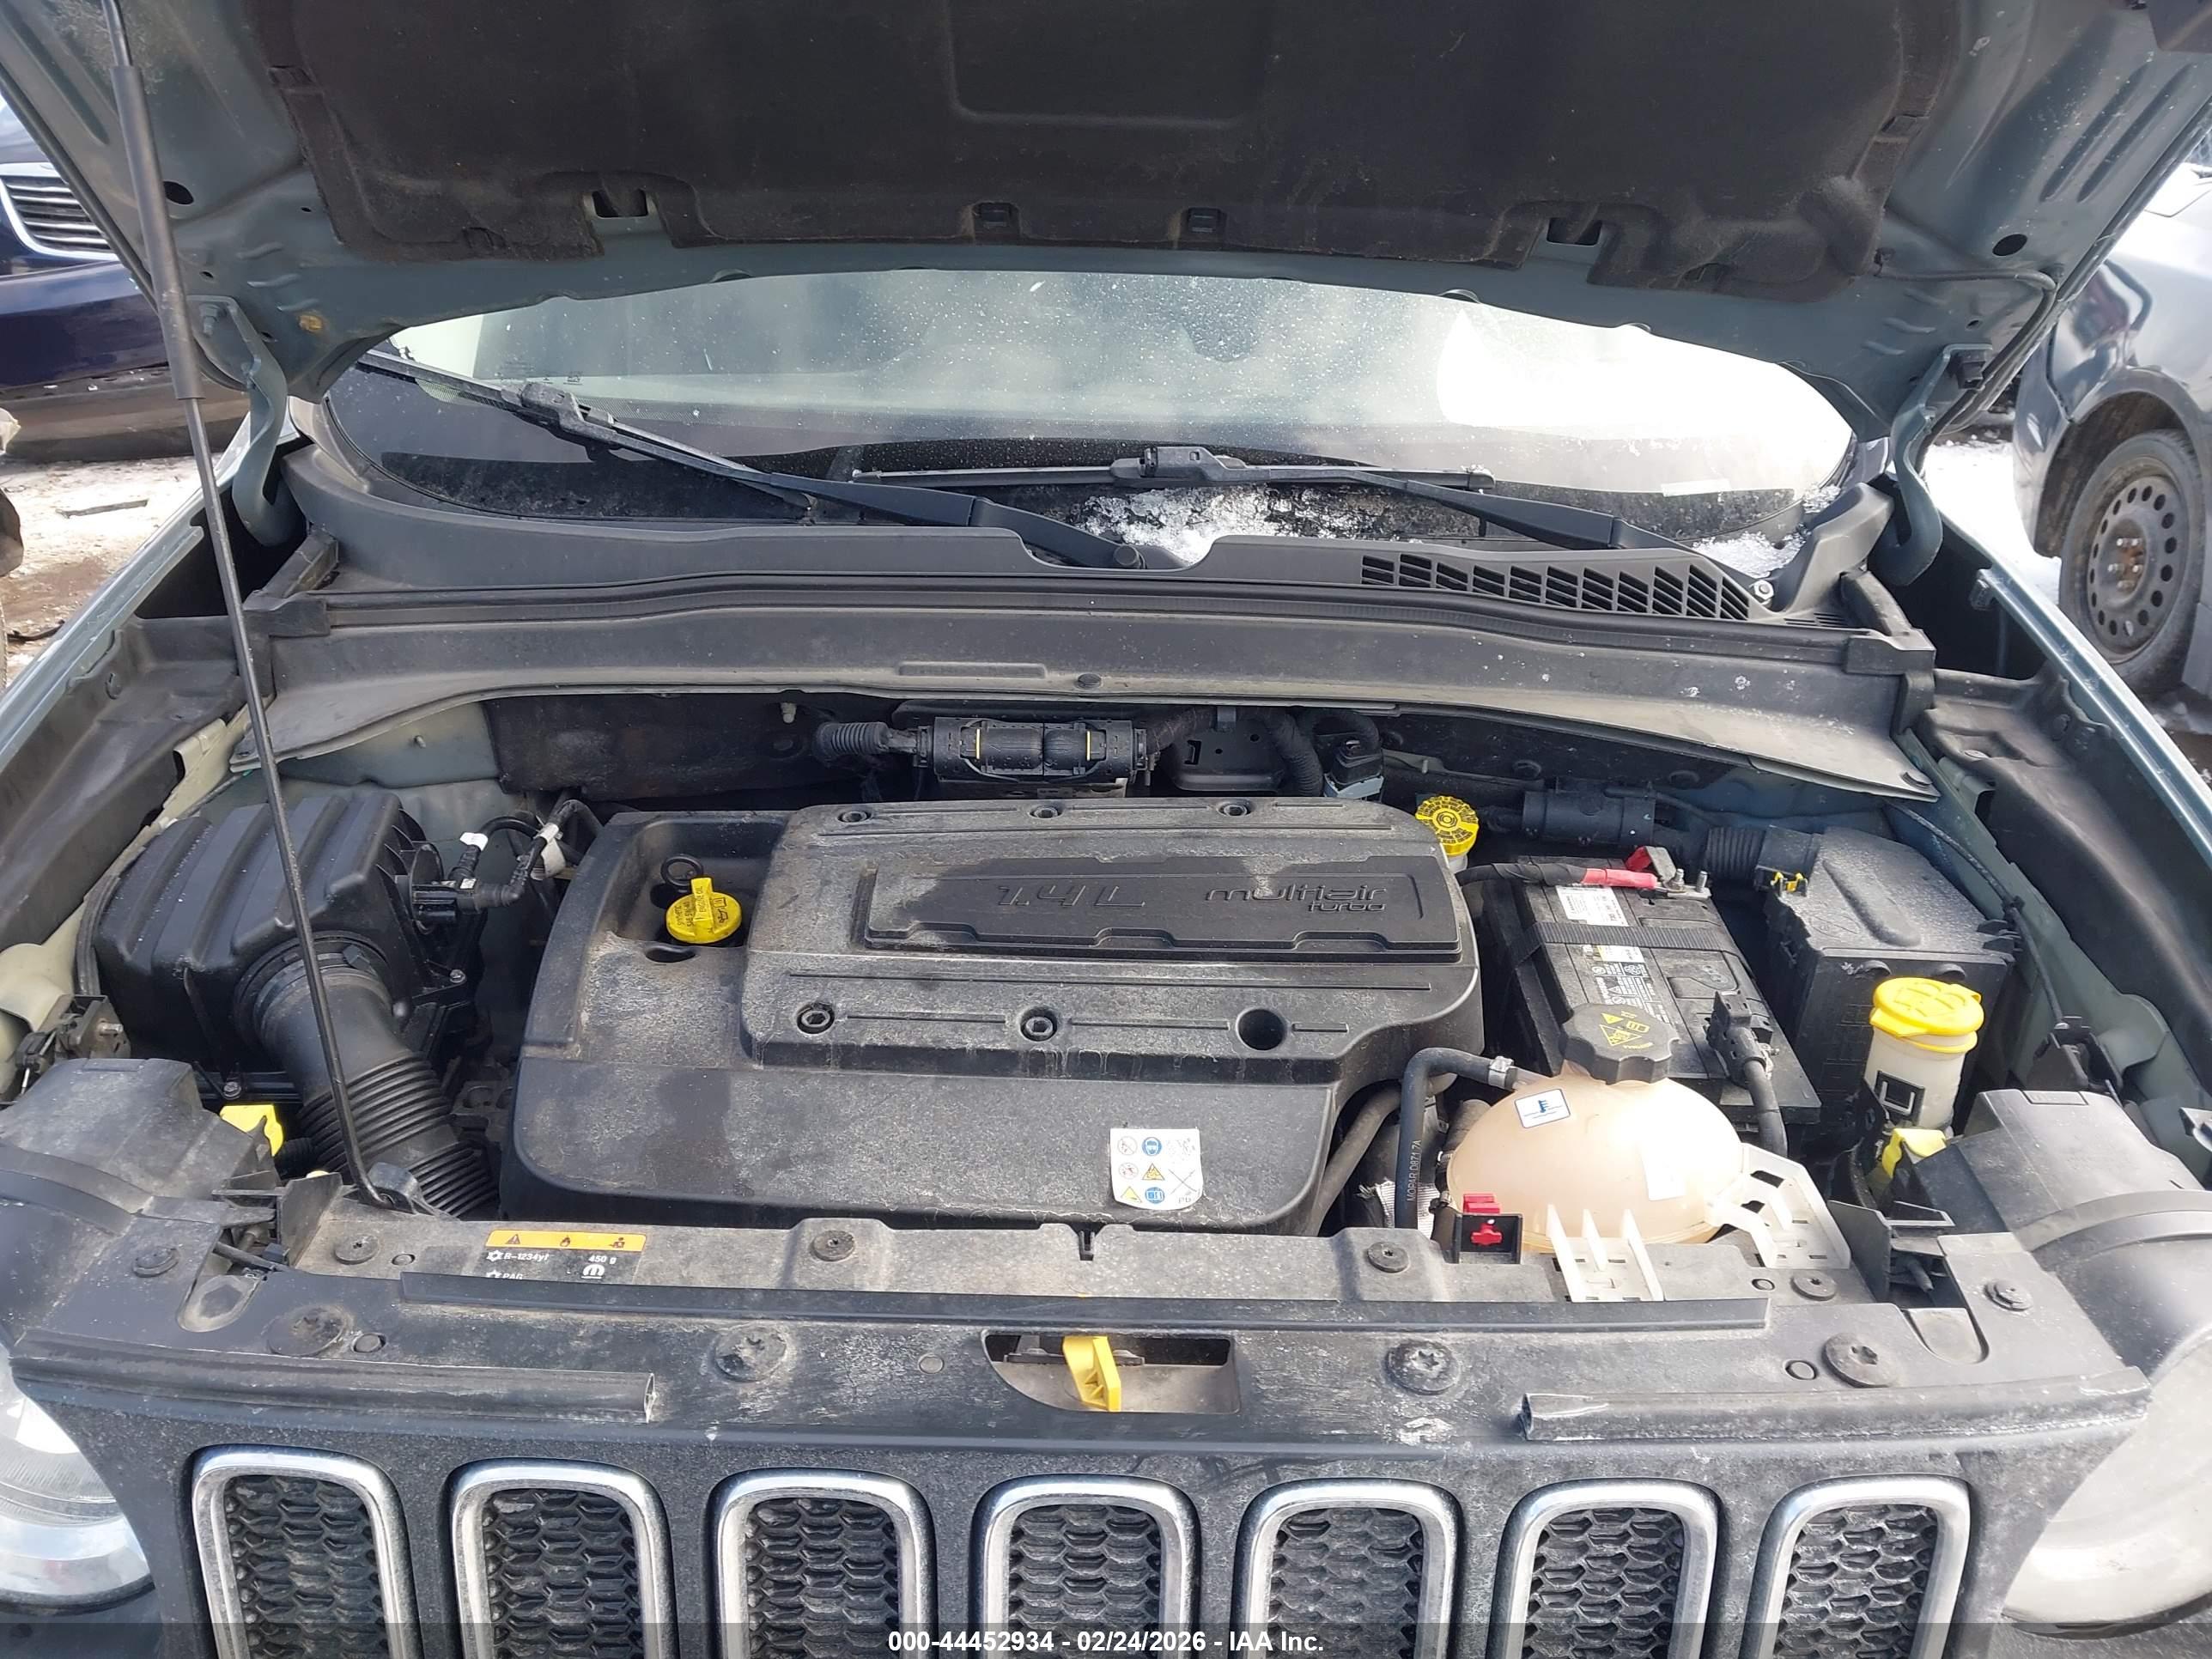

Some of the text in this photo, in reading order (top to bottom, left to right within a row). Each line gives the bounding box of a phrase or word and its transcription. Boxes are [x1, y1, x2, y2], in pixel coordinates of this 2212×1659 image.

[695, 886, 707, 913] ENGINE OIL
[1206, 883, 1387, 901] multiair
[1308, 901, 1386, 912] turbo
[1407, 1172, 1417, 1200] MOPAR
[503, 1253, 617, 1265] R-1234yf 450 g
